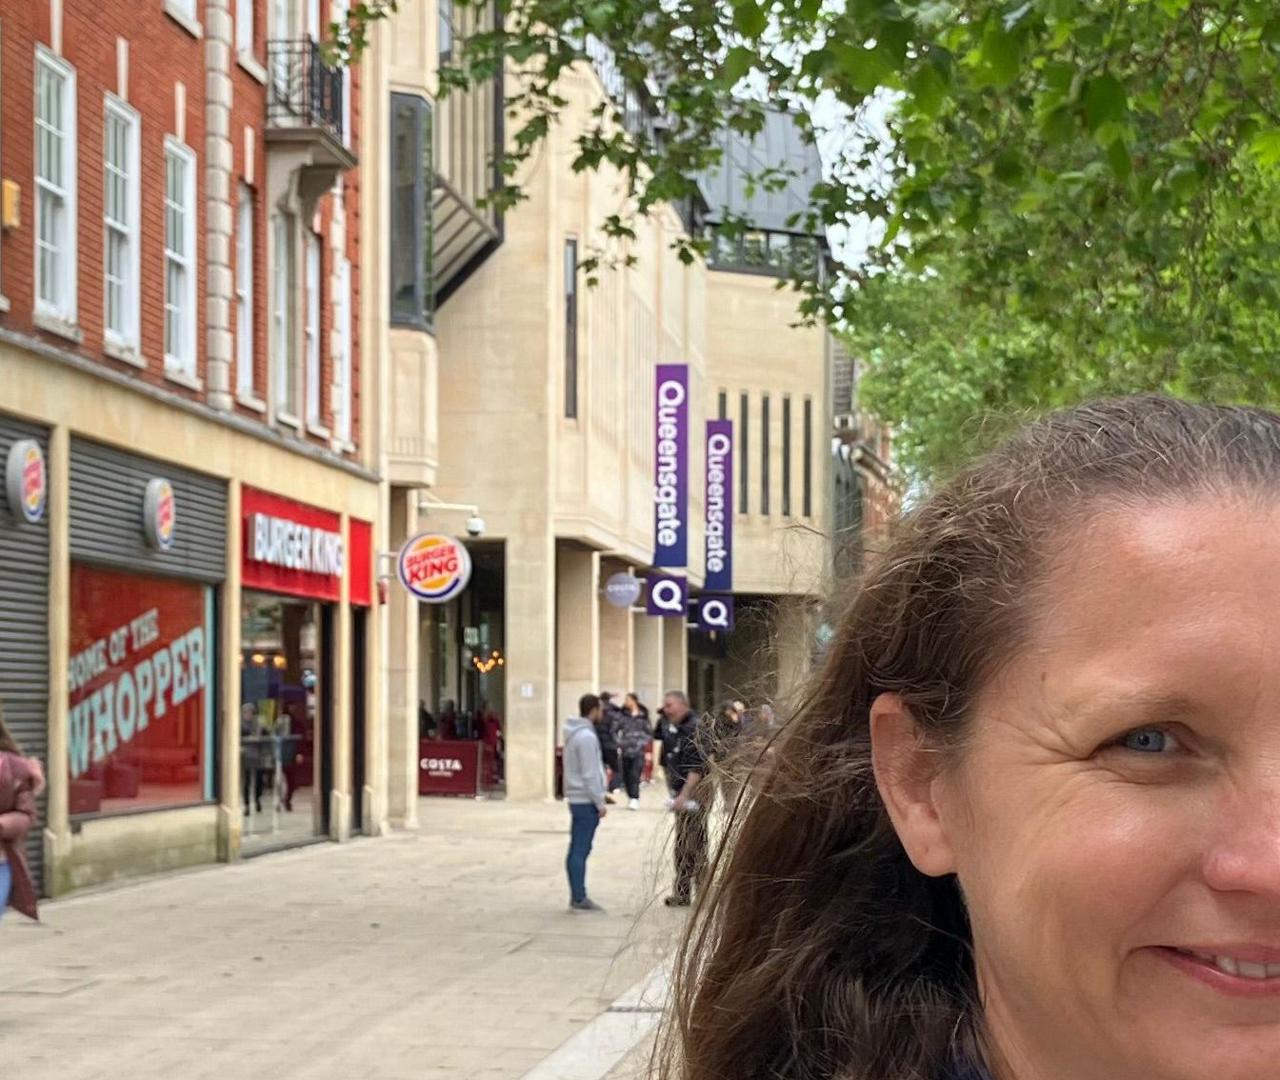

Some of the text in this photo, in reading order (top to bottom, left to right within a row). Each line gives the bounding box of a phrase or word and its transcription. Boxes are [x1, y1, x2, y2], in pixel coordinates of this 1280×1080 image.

[654, 380, 685, 546] Queensgate
[705, 433, 731, 573] Queensgate
[255, 512, 342, 577] BURGER KING
[406, 545, 456, 568] BURGER
[409, 557, 458, 584] KING
[652, 580, 683, 612] Q
[109, 626, 128, 664] OF
[68, 627, 206, 779] WHOPPER
